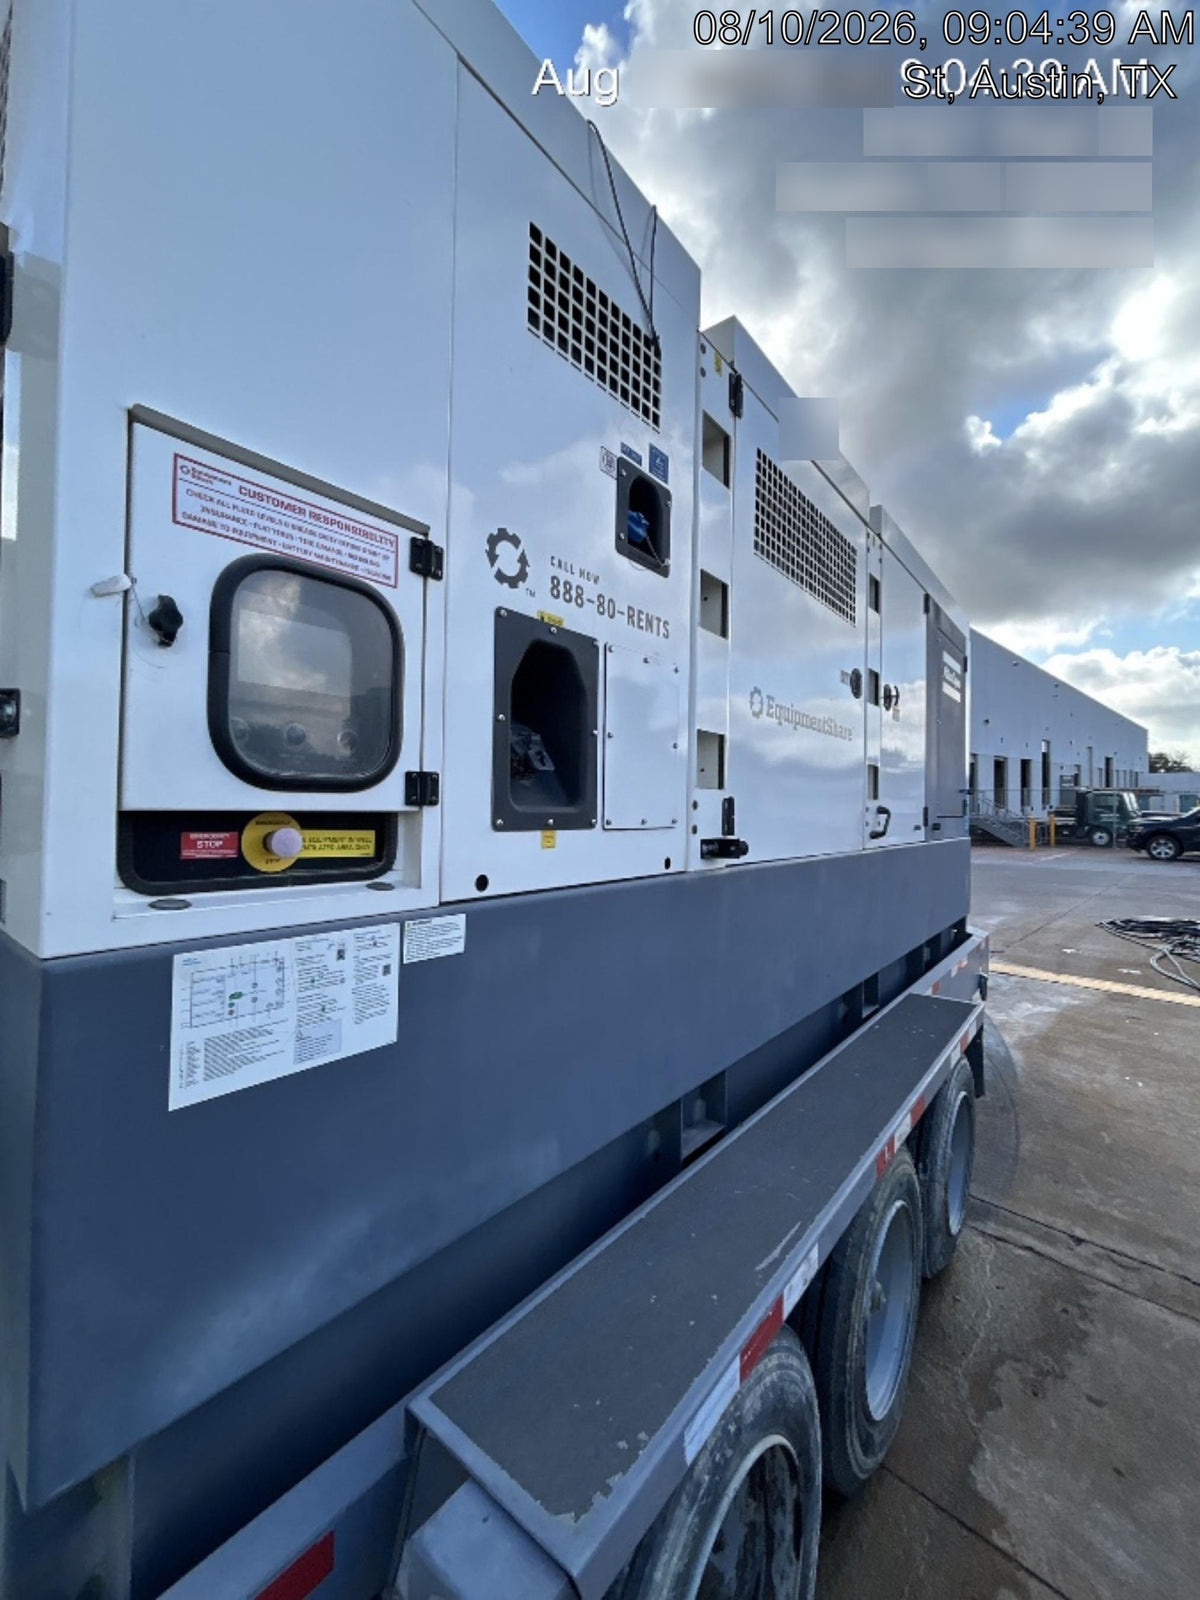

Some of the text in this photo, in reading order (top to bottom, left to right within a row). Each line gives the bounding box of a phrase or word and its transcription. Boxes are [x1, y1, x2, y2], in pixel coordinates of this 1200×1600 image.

[239, 485, 306, 517] CUSTOMER
[309, 510, 395, 548] RESPONSIBILITY
[550, 556, 600, 585] CALL NOW
[550, 575, 670, 639] 888-80-RENTS
[766, 694, 853, 742] EquipmentShare
[196, 840, 223, 848] STOP
